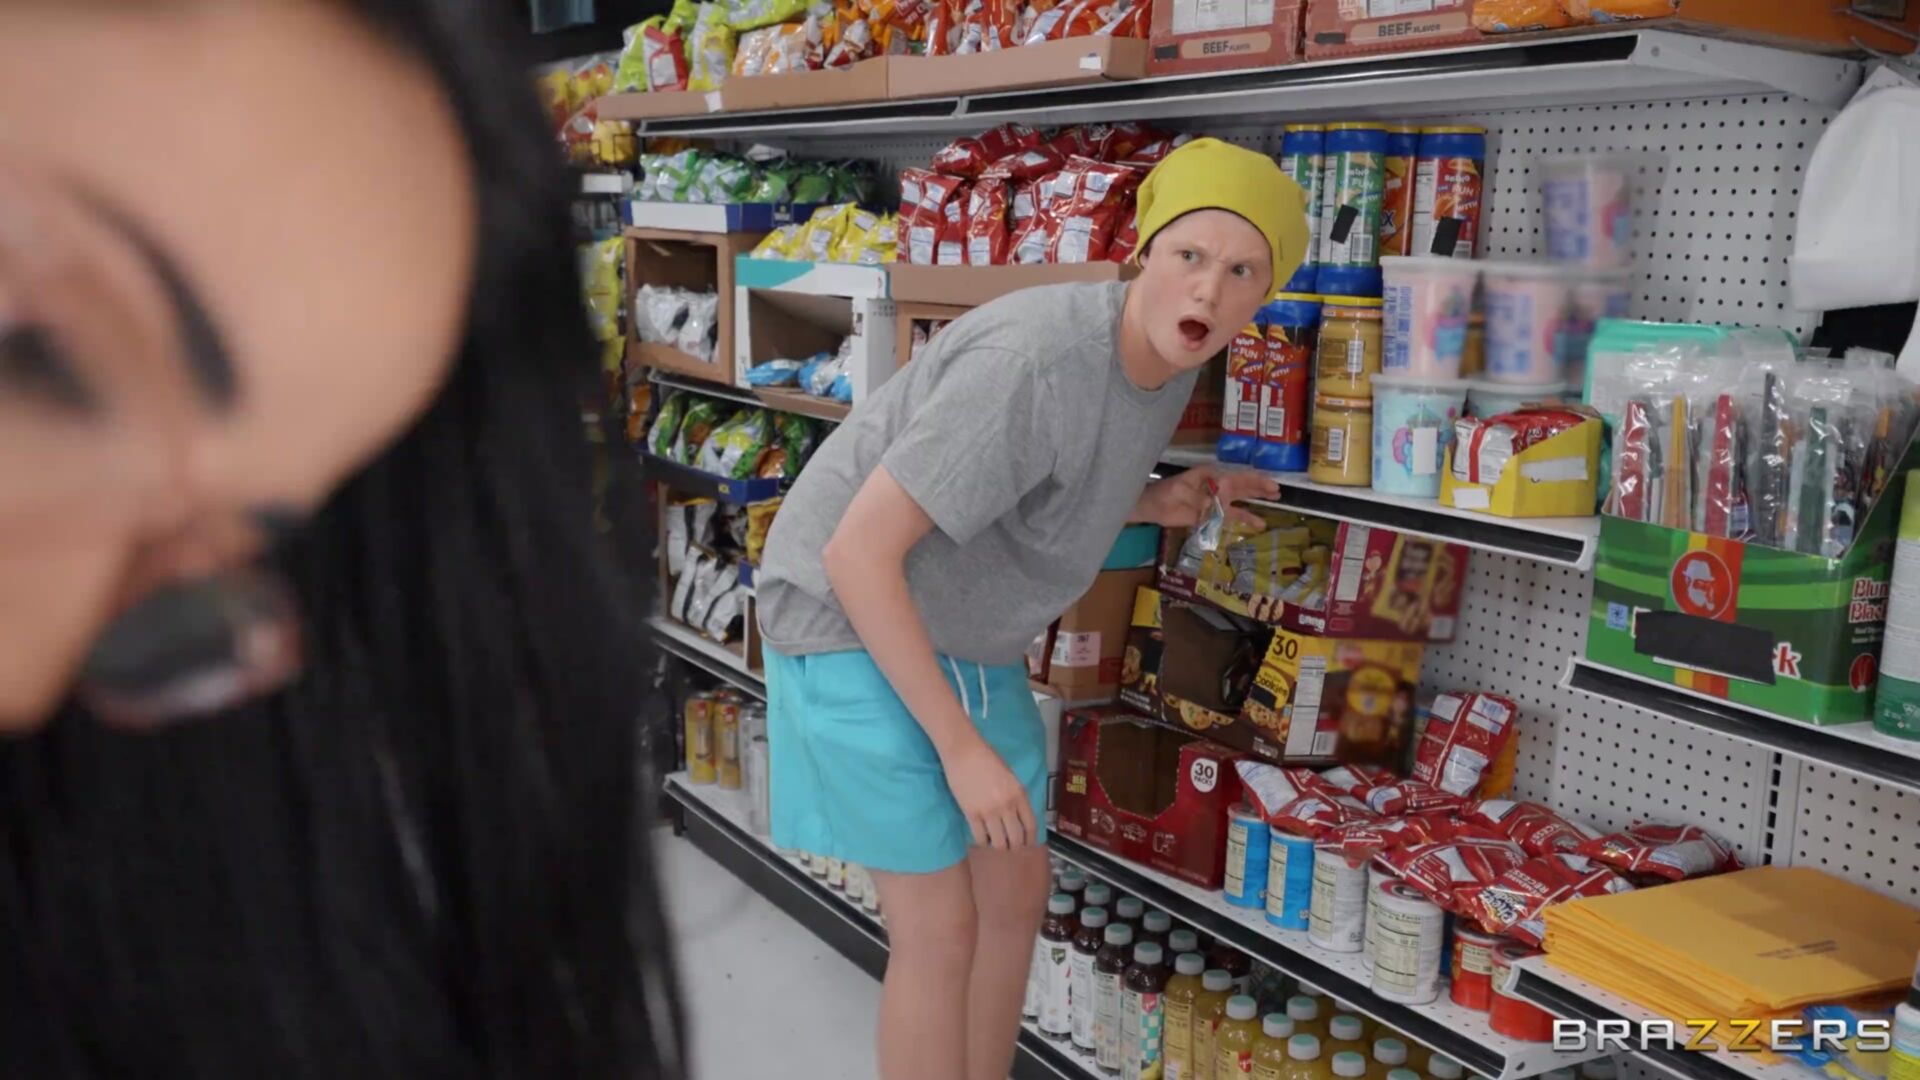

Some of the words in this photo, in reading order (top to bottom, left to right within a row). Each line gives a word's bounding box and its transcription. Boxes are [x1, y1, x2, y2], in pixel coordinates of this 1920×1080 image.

[1378, 21, 1412, 37] BEEF
[1202, 40, 1229, 54] BEEF
[1452, 184, 1475, 197] FUN
[1240, 347, 1259, 359] FUN
[1852, 577, 1888, 600] Blun
[1272, 634, 1298, 660] 30
[1194, 762, 1214, 780] 30
[1194, 775, 1213, 787] PACKS
